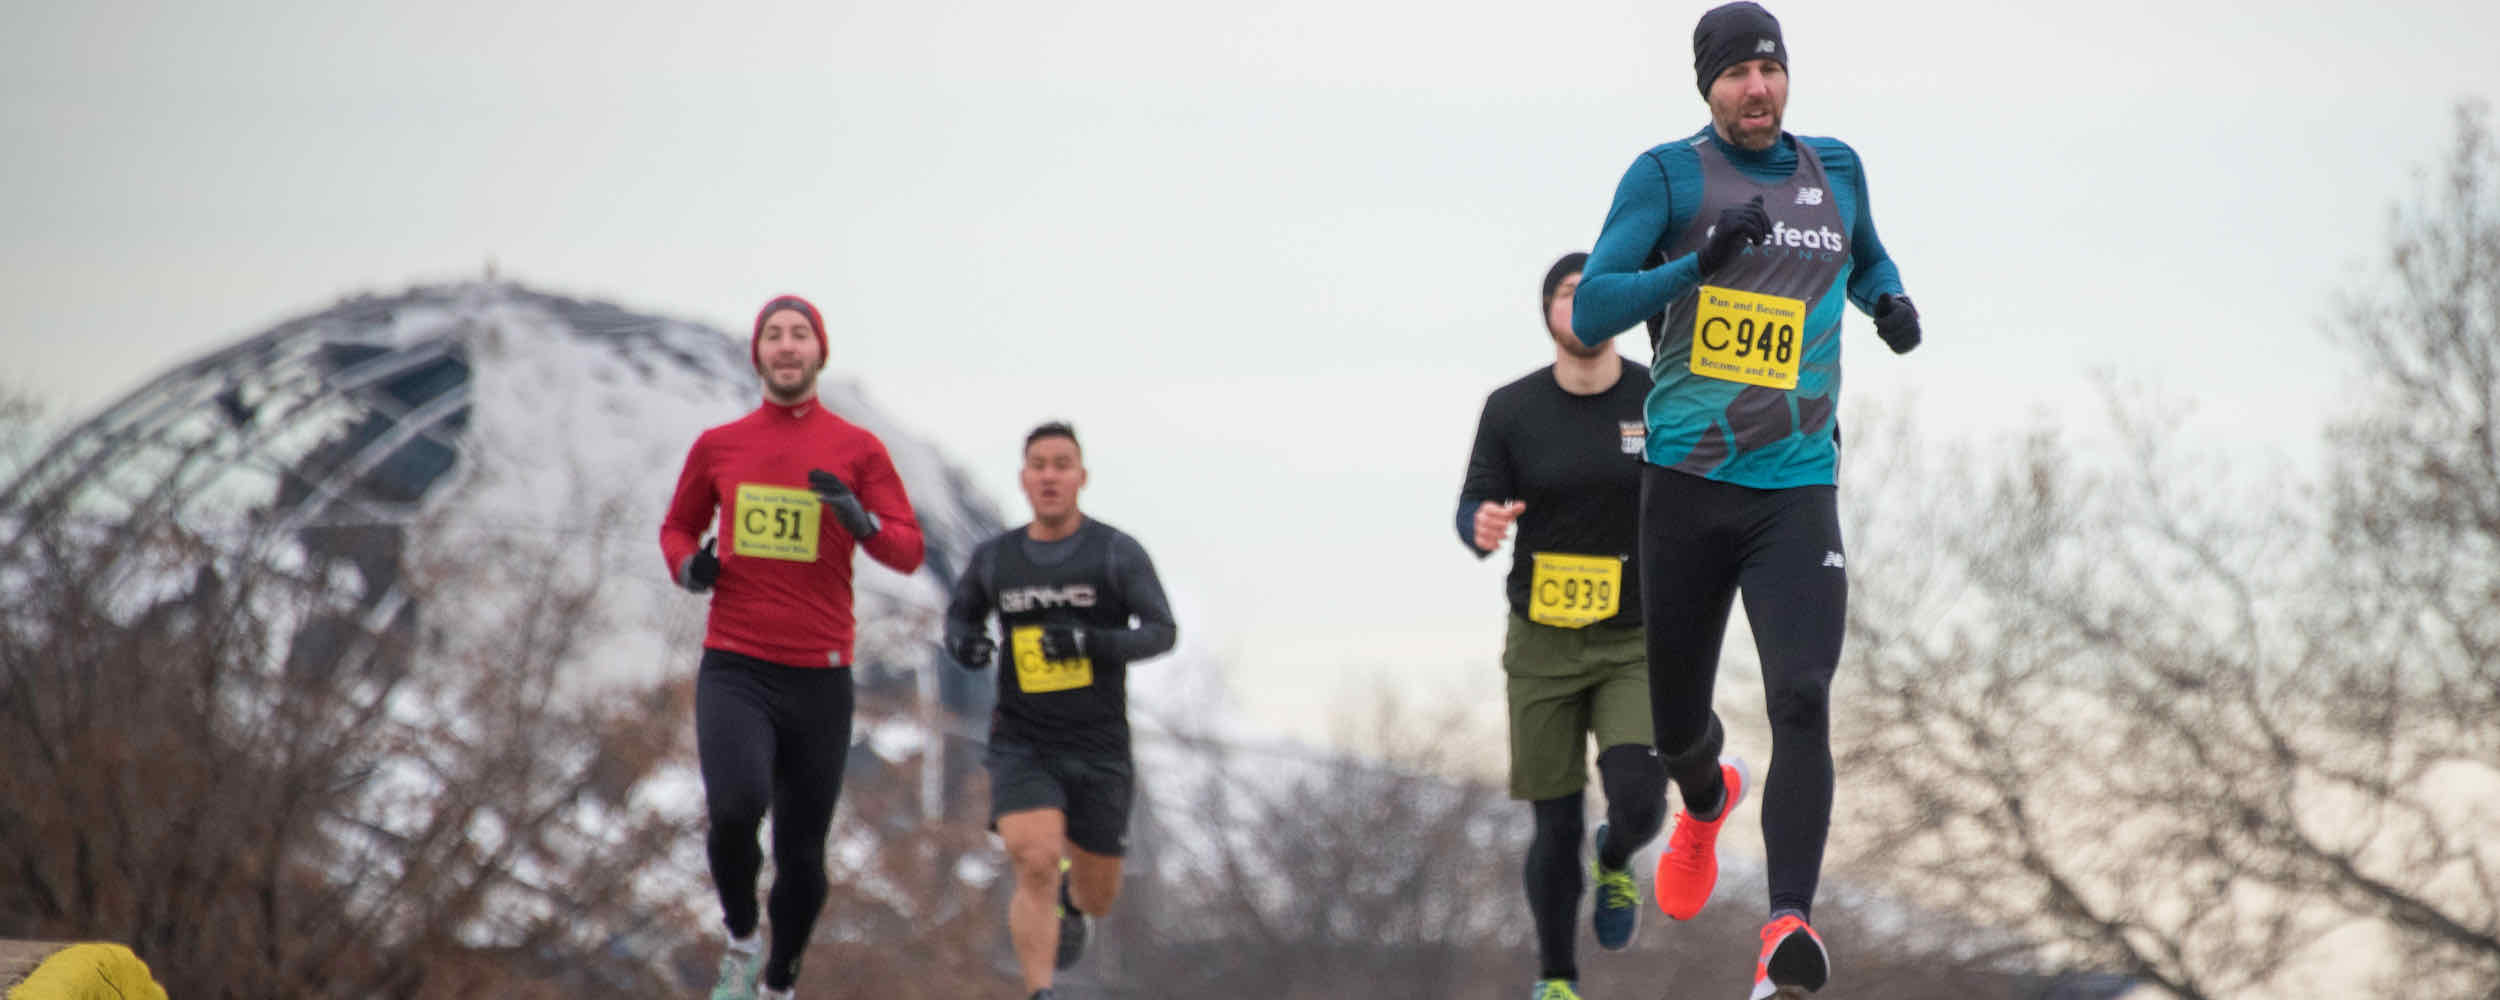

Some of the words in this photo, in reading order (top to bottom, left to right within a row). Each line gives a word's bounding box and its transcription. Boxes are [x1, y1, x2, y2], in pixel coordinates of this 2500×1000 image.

[1794, 187, 1824, 206] NB
[1742, 246, 1833, 263] ACING
[1710, 296, 1729, 308] Run
[1733, 301, 1753, 312] and
[1756, 303, 1796, 318] Become
[1702, 317, 1795, 364] C948
[1701, 356, 1740, 372] Become
[1744, 366, 1764, 377] and
[1768, 366, 1787, 379] Run
